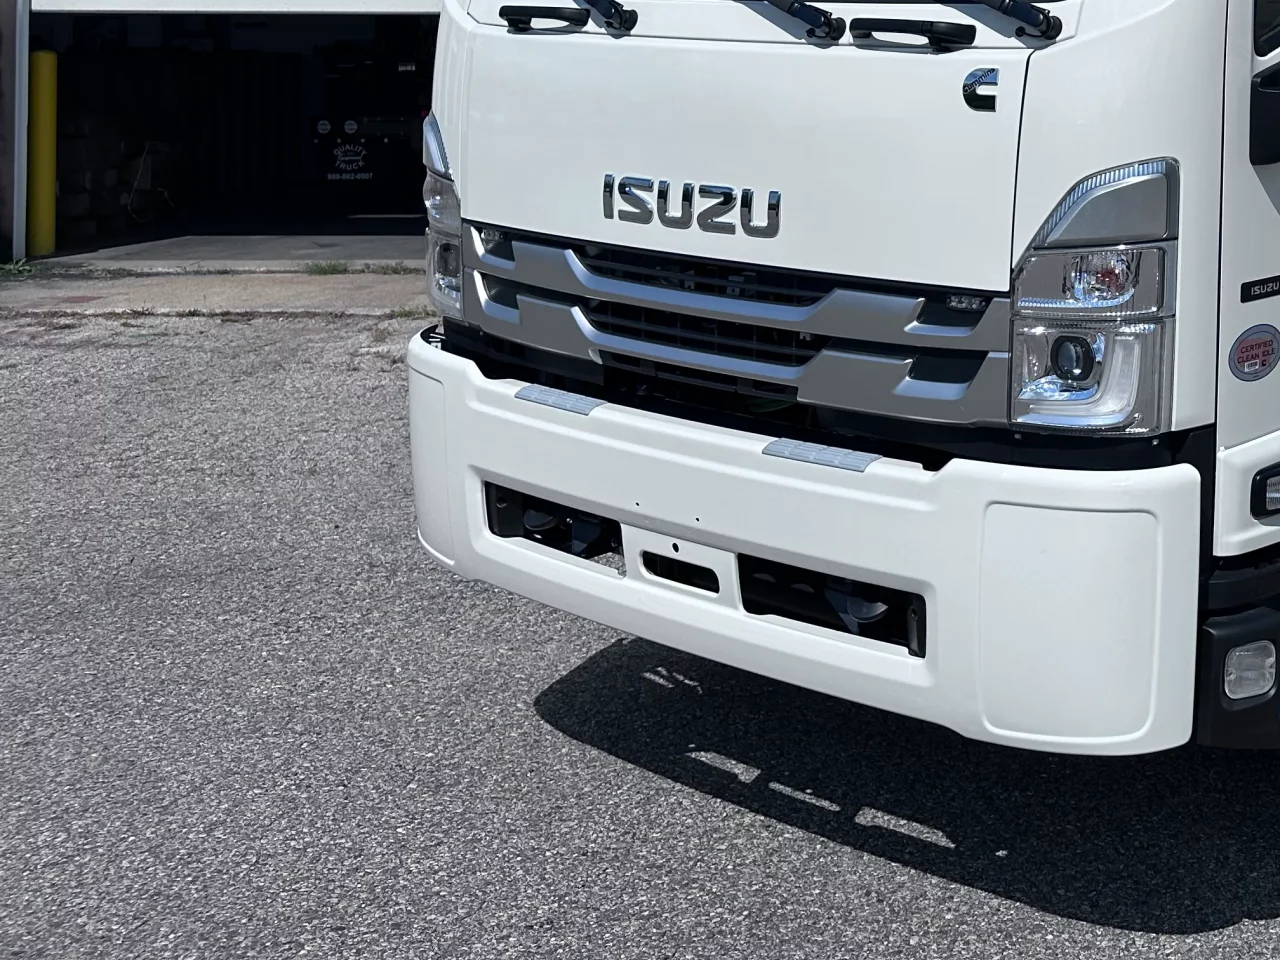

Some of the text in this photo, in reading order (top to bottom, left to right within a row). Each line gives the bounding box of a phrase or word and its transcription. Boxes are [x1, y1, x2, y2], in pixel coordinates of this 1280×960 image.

[963, 68, 996, 94] Cummins
[333, 144, 368, 156] QUALITY
[335, 159, 366, 171] TRUCK
[602, 173, 782, 239] ISUZU
[1251, 281, 1280, 296] ISUZU
[1240, 339, 1274, 354] CERTIFIED
[1237, 347, 1276, 364] CLEAN IDLE
